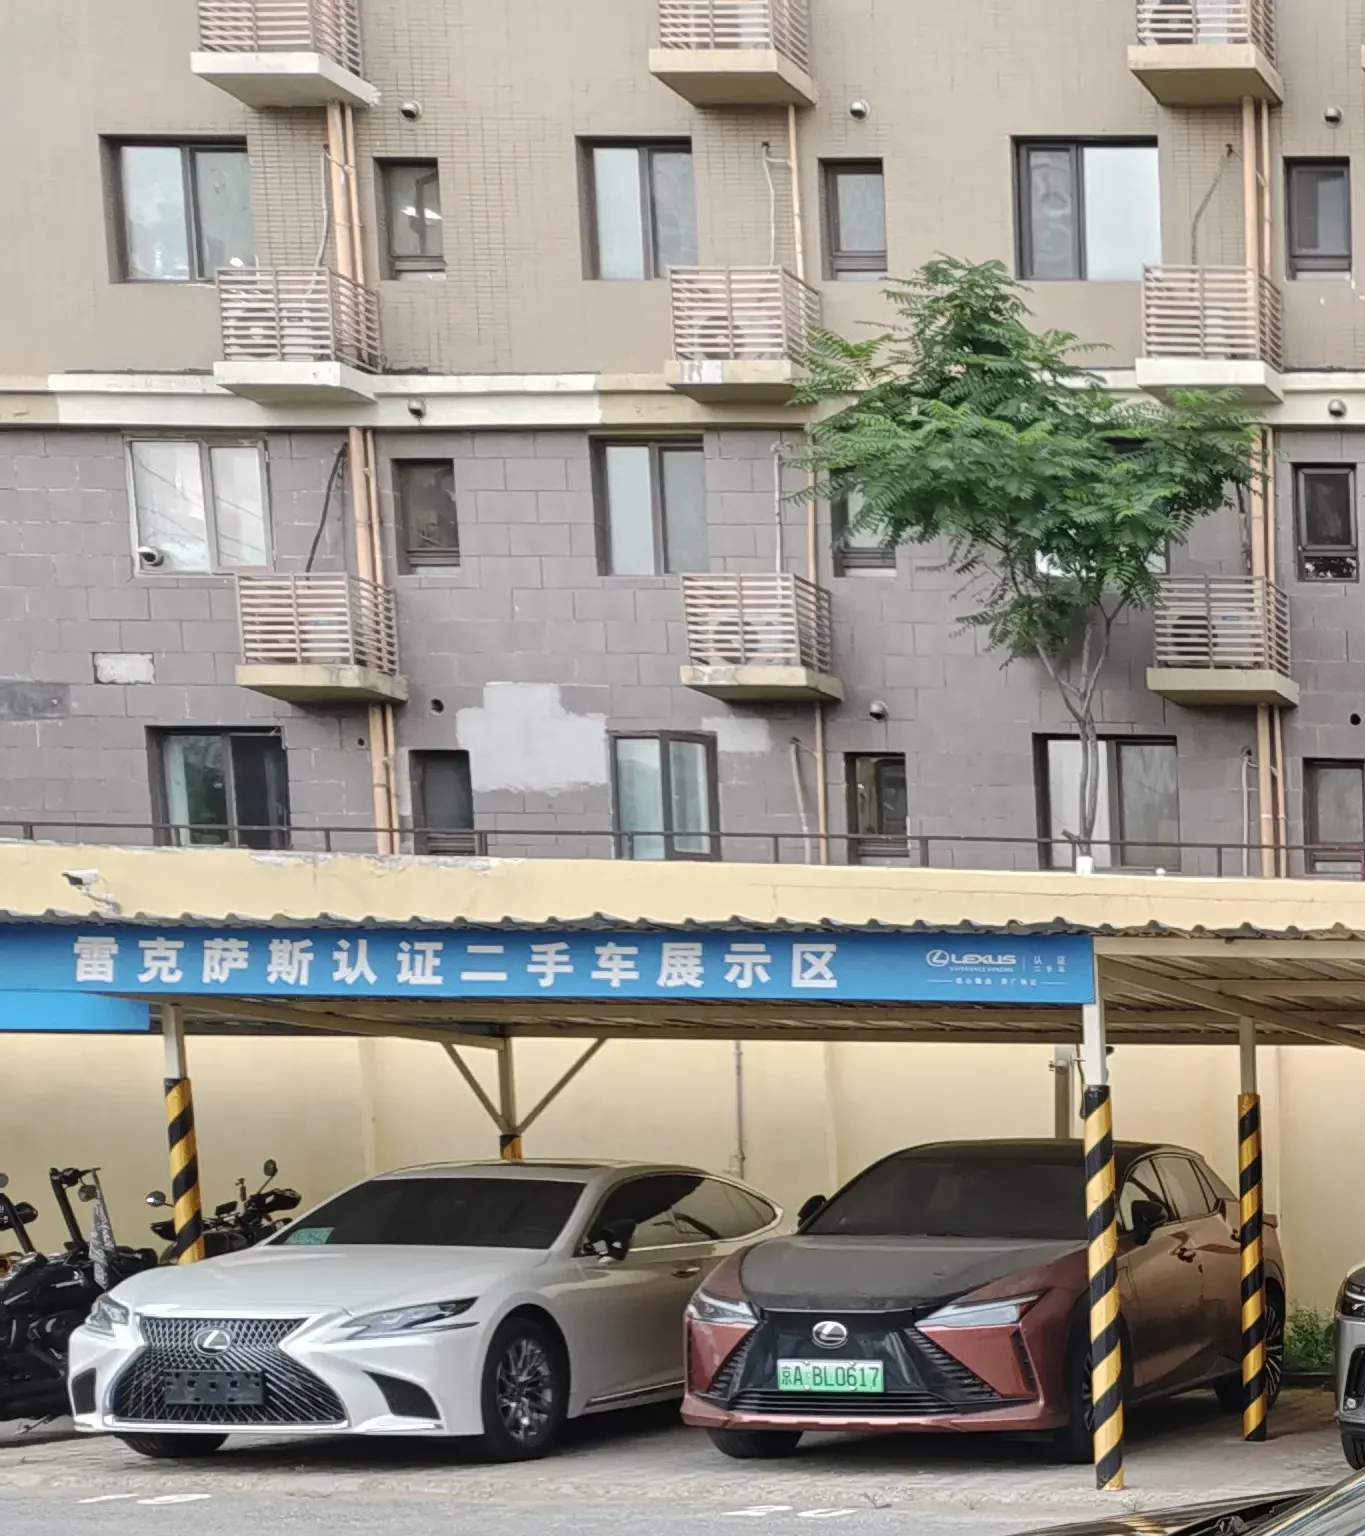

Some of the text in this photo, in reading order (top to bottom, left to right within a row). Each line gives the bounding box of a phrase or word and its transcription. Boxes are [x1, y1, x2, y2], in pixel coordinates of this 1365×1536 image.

[73, 935, 838, 988] 雷克萨斯认证二手车展示区
[951, 954, 1016, 965] LEXUS
